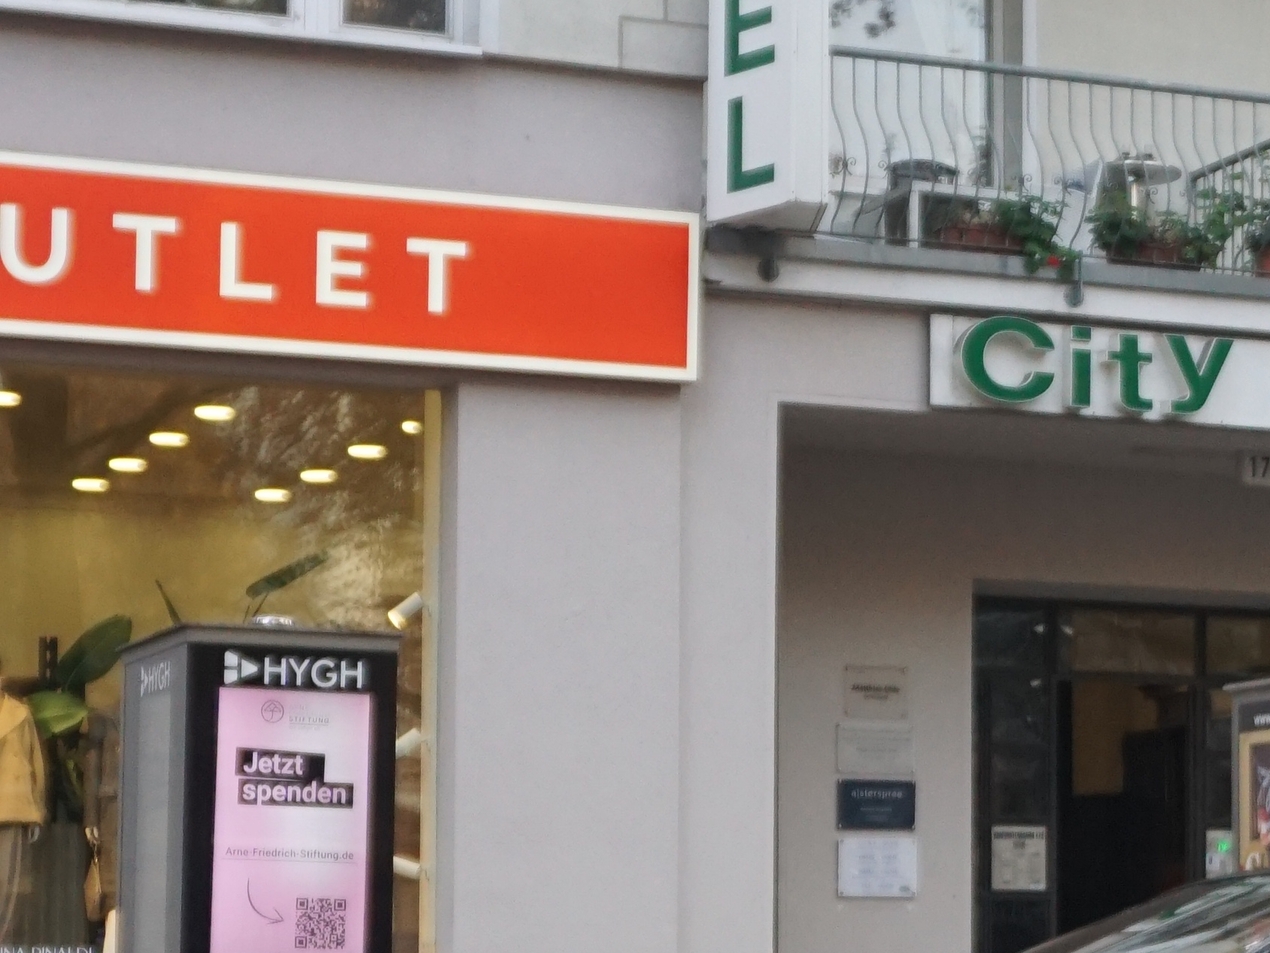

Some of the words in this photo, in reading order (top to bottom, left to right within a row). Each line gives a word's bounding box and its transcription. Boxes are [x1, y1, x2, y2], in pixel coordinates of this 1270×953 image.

[960, 315, 1235, 414] City
[148, 661, 171, 694] HYGH
[263, 656, 363, 689] HYGH
[242, 751, 304, 775] Jetzt
[241, 780, 347, 806] spenden
[225, 846, 355, 862] Arne-Friedrich-Stiftung.de
